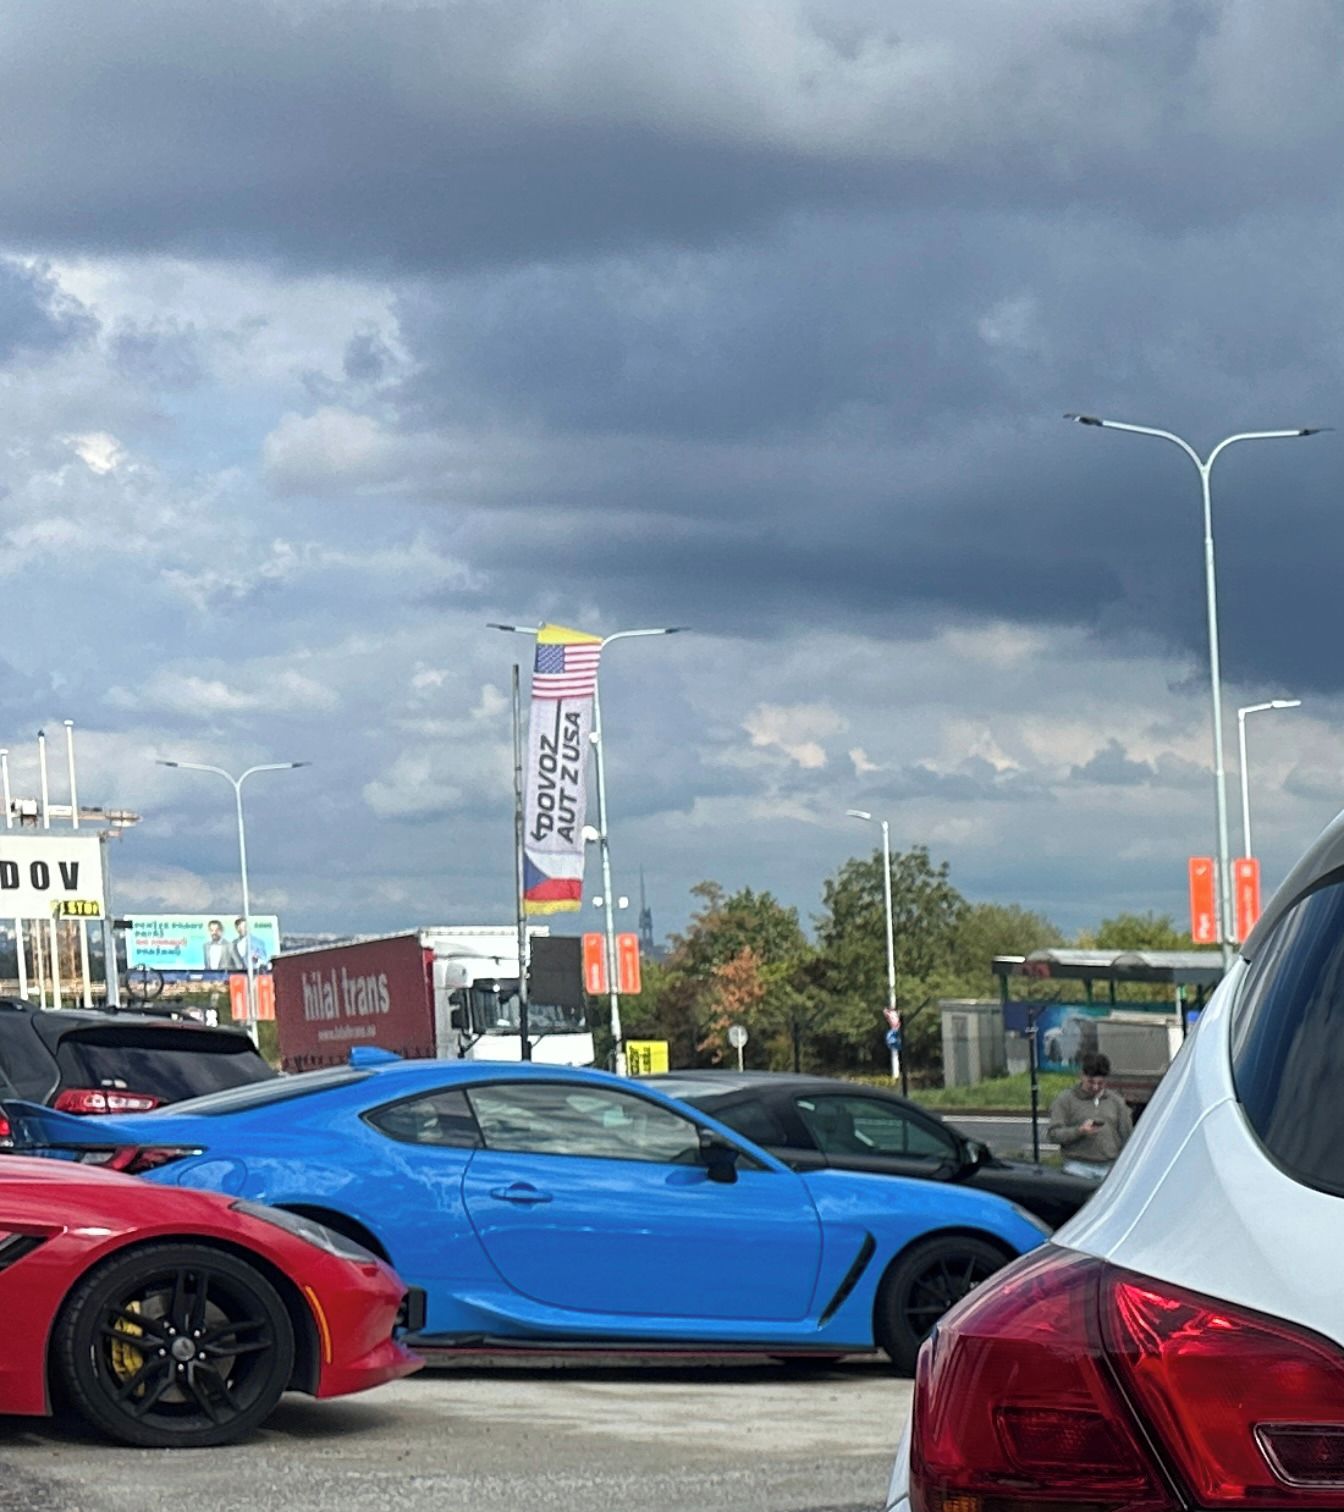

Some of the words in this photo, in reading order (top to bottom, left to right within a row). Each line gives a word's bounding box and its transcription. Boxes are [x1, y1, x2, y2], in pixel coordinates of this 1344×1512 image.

[563, 711, 582, 763] USA
[531, 733, 560, 842] DOVOZ
[561, 765, 579, 785] Z
[557, 788, 578, 844] AUT
[302, 968, 340, 1021] hilal
[341, 966, 391, 1017] trans
